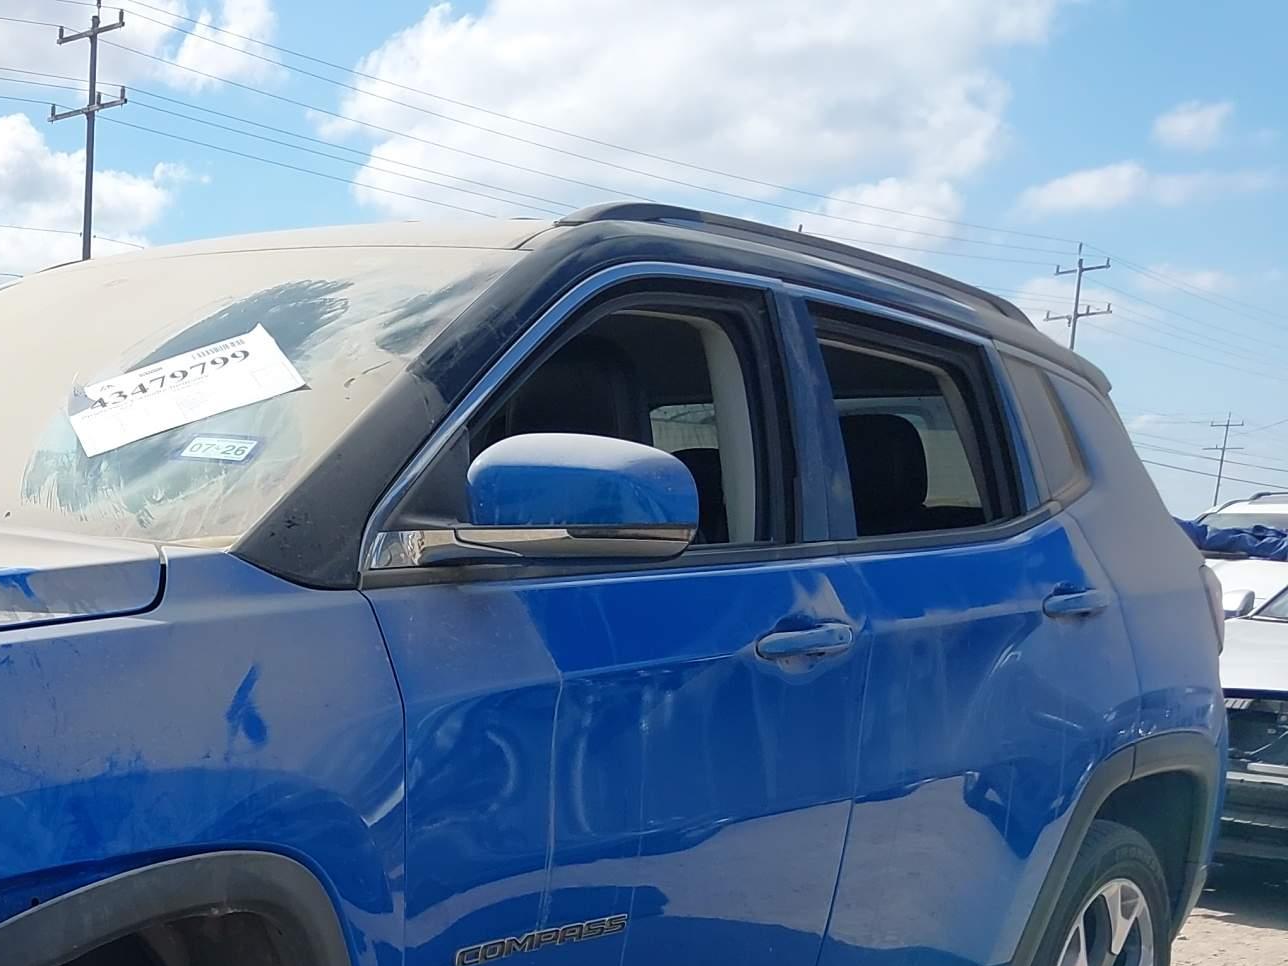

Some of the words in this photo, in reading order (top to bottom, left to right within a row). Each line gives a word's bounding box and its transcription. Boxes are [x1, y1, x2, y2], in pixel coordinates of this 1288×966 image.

[89, 349, 250, 410] 43479799
[189, 443, 216, 453] 07
[220, 444, 249, 456] 26
